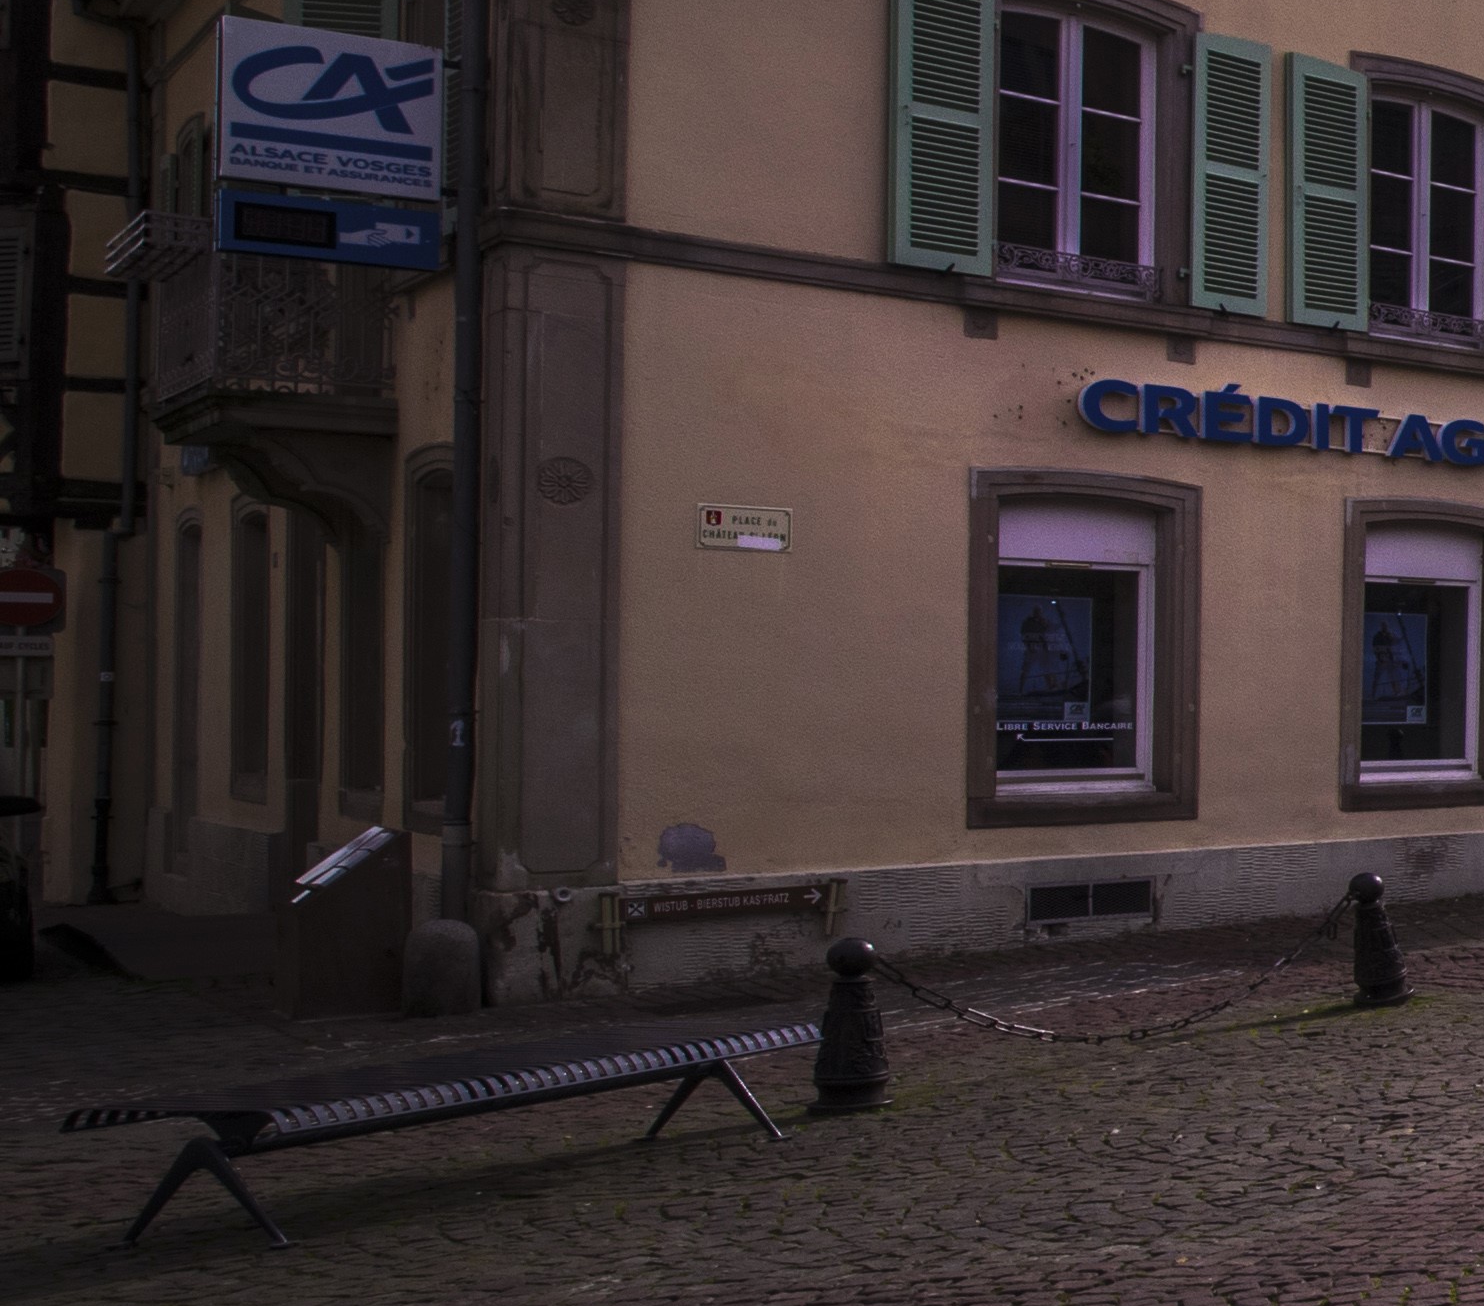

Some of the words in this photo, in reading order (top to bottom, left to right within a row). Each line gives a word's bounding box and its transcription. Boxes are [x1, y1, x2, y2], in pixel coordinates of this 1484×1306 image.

[231, 143, 328, 165] ALSACE
[337, 156, 432, 177] VOSGES
[230, 156, 298, 172] BANQUE
[304, 165, 325, 175] ET
[328, 168, 433, 187] ASSURANCES
[1078, 379, 1380, 455] CRÉDIT
[732, 515, 762, 526] PLACE
[767, 518, 777, 526] du
[18, 641, 50, 650] CYCLES
[996, 721, 1028, 731] LIBRE
[1033, 721, 1078, 731] SERVICE
[1082, 721, 1133, 730] BANCAIRE
[653, 900, 688, 913] WISTUB
[696, 895, 741, 910] BIERSTUB
